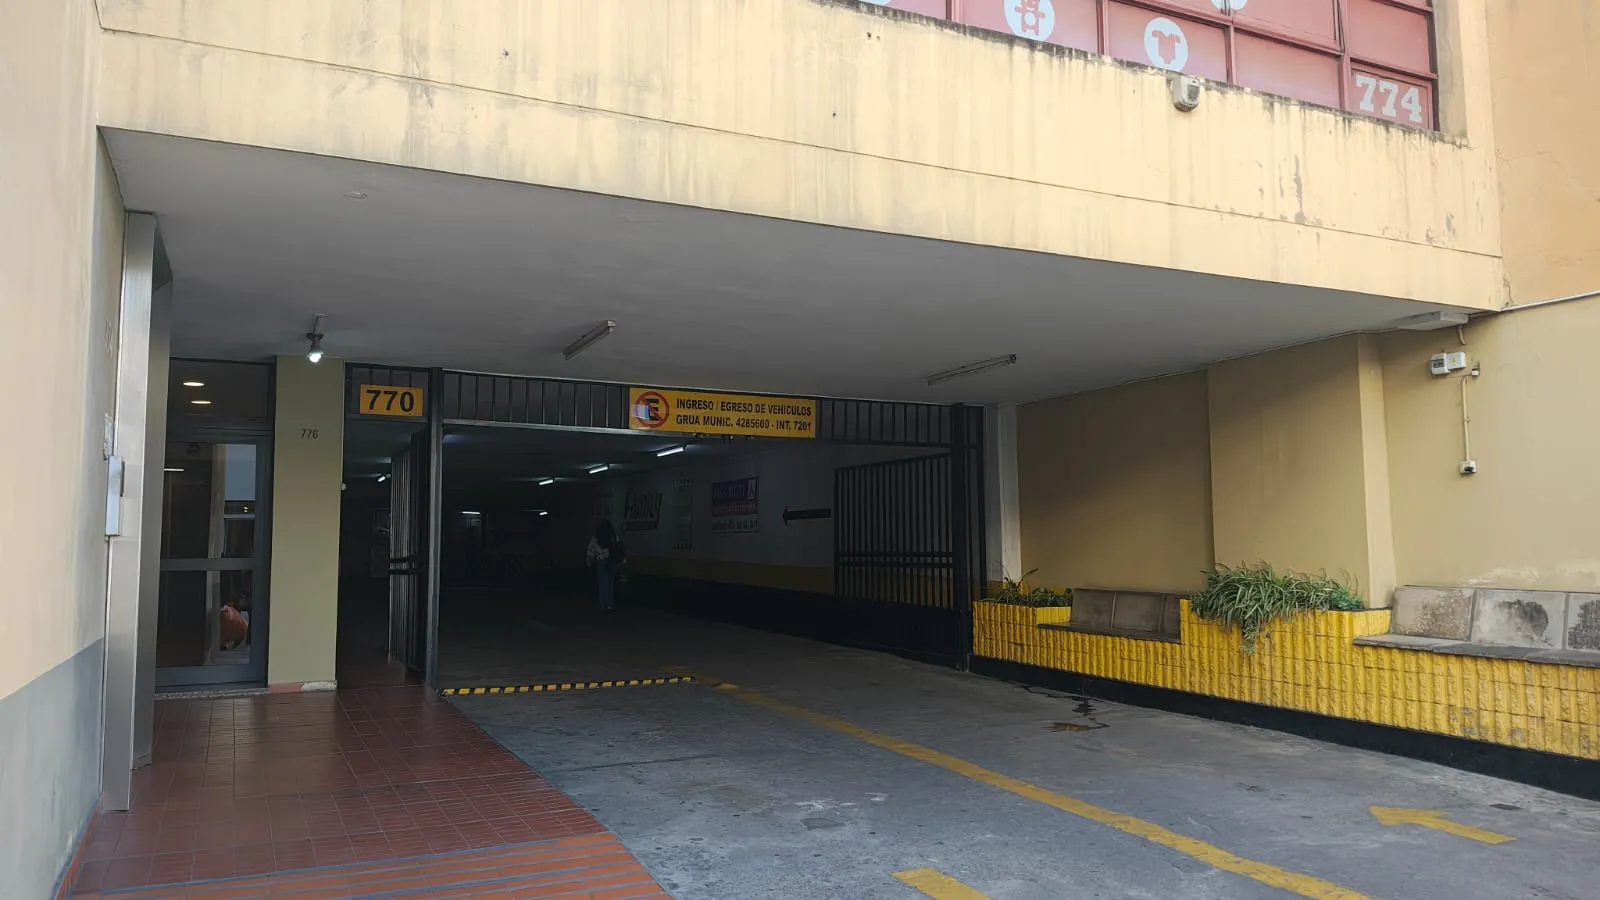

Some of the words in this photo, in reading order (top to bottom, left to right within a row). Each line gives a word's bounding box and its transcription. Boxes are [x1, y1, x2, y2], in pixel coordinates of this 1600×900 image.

[1355, 74, 1422, 123] 774
[366, 389, 415, 412] 770
[676, 398, 714, 411] INGRESO
[720, 401, 753, 413] EGRESO
[755, 404, 766, 414] DE
[767, 405, 812, 417] VEHICULOS
[676, 414, 700, 426] GRUA
[736, 418, 770, 428] 4285600
[793, 421, 811, 431] 7201
[300, 428, 319, 440] 776
